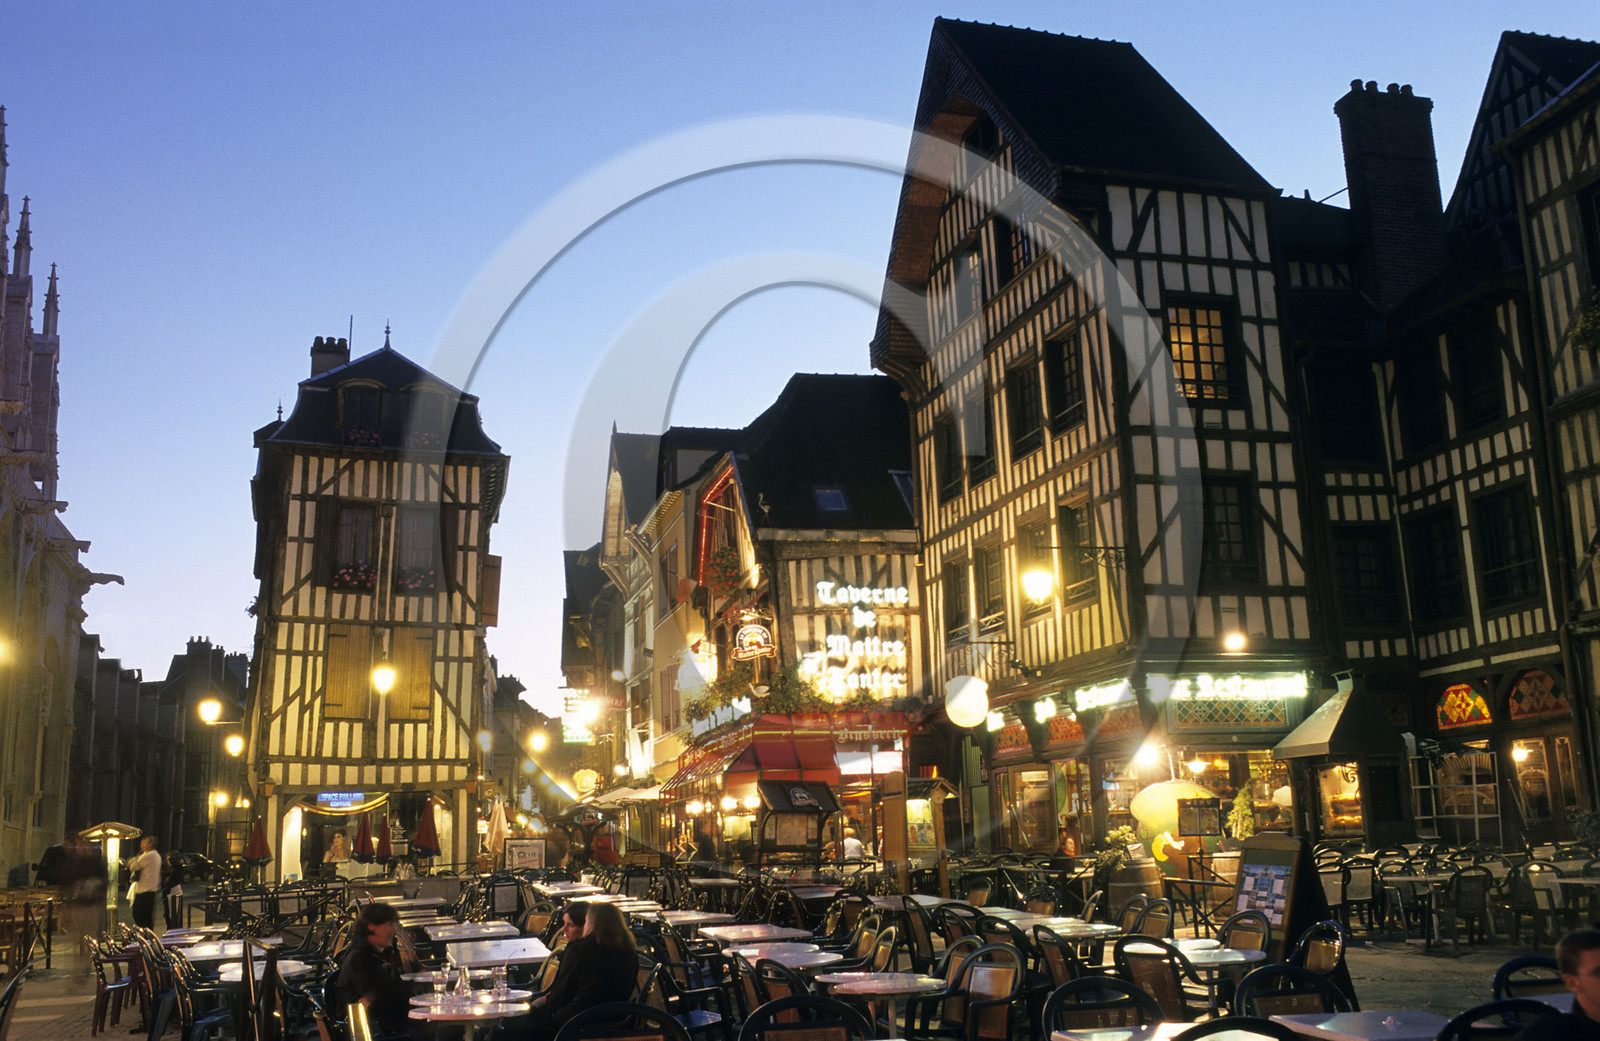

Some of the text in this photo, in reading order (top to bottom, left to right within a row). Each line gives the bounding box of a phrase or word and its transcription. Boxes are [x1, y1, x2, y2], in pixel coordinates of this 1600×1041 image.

[816, 581, 909, 604] Taverne
[852, 605, 877, 628] de
[825, 667, 905, 690] Kanter
